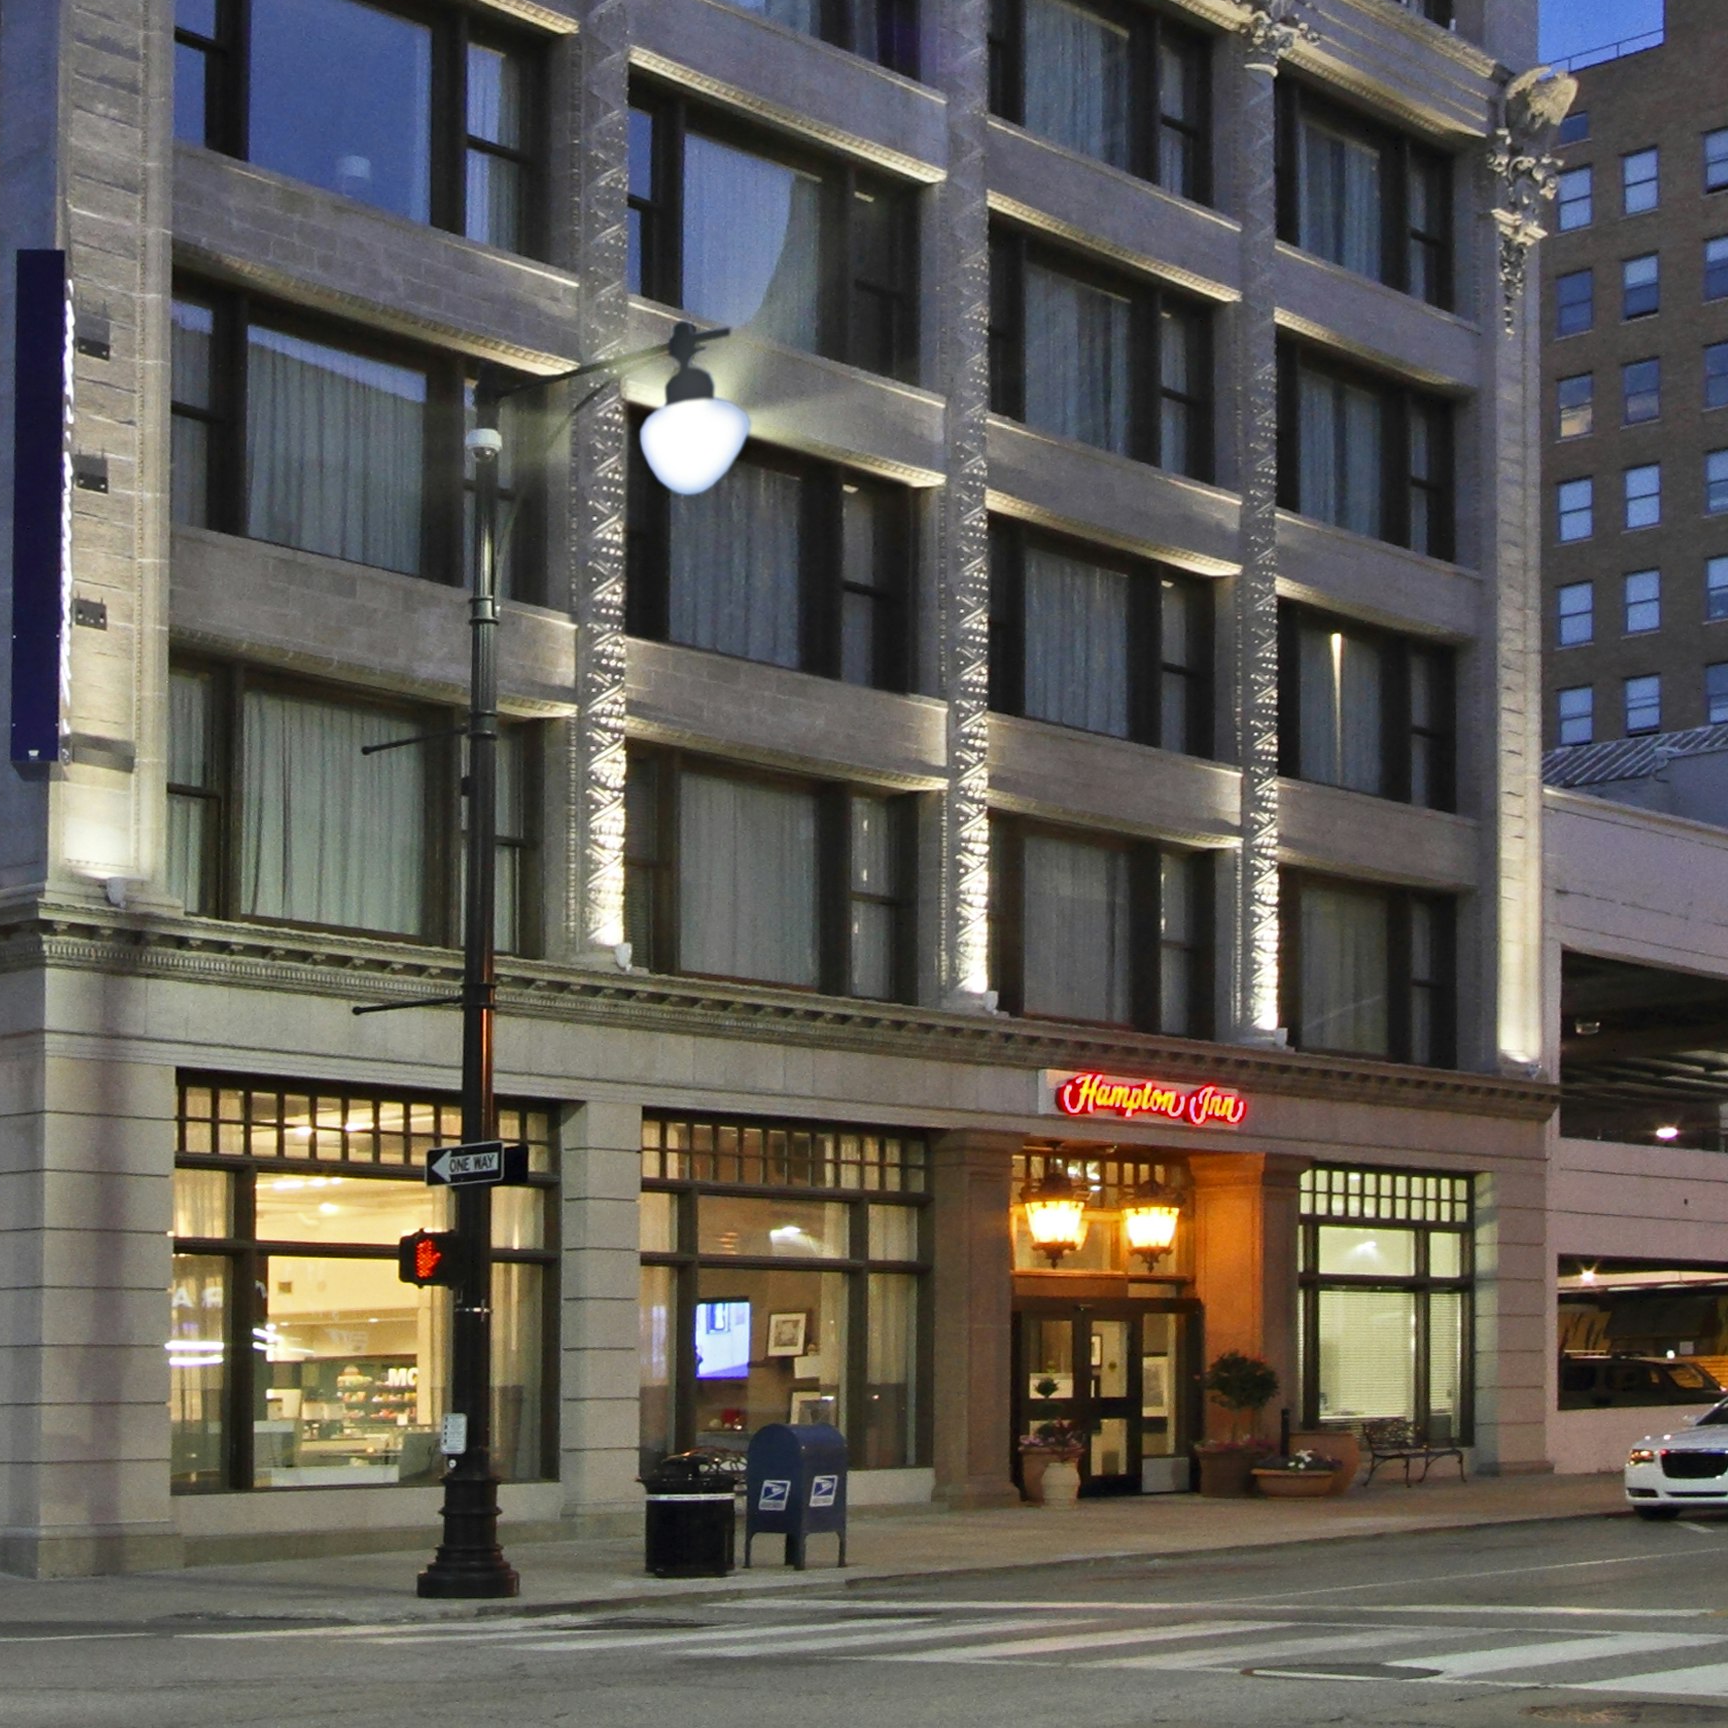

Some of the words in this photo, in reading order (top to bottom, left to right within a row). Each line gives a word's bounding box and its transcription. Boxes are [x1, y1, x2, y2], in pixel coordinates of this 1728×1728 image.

[1062, 1073, 1186, 1118] Hampton
[1188, 1085, 1245, 1124] Inn
[449, 1156, 471, 1173] ONE
[473, 1154, 495, 1170] WAY
